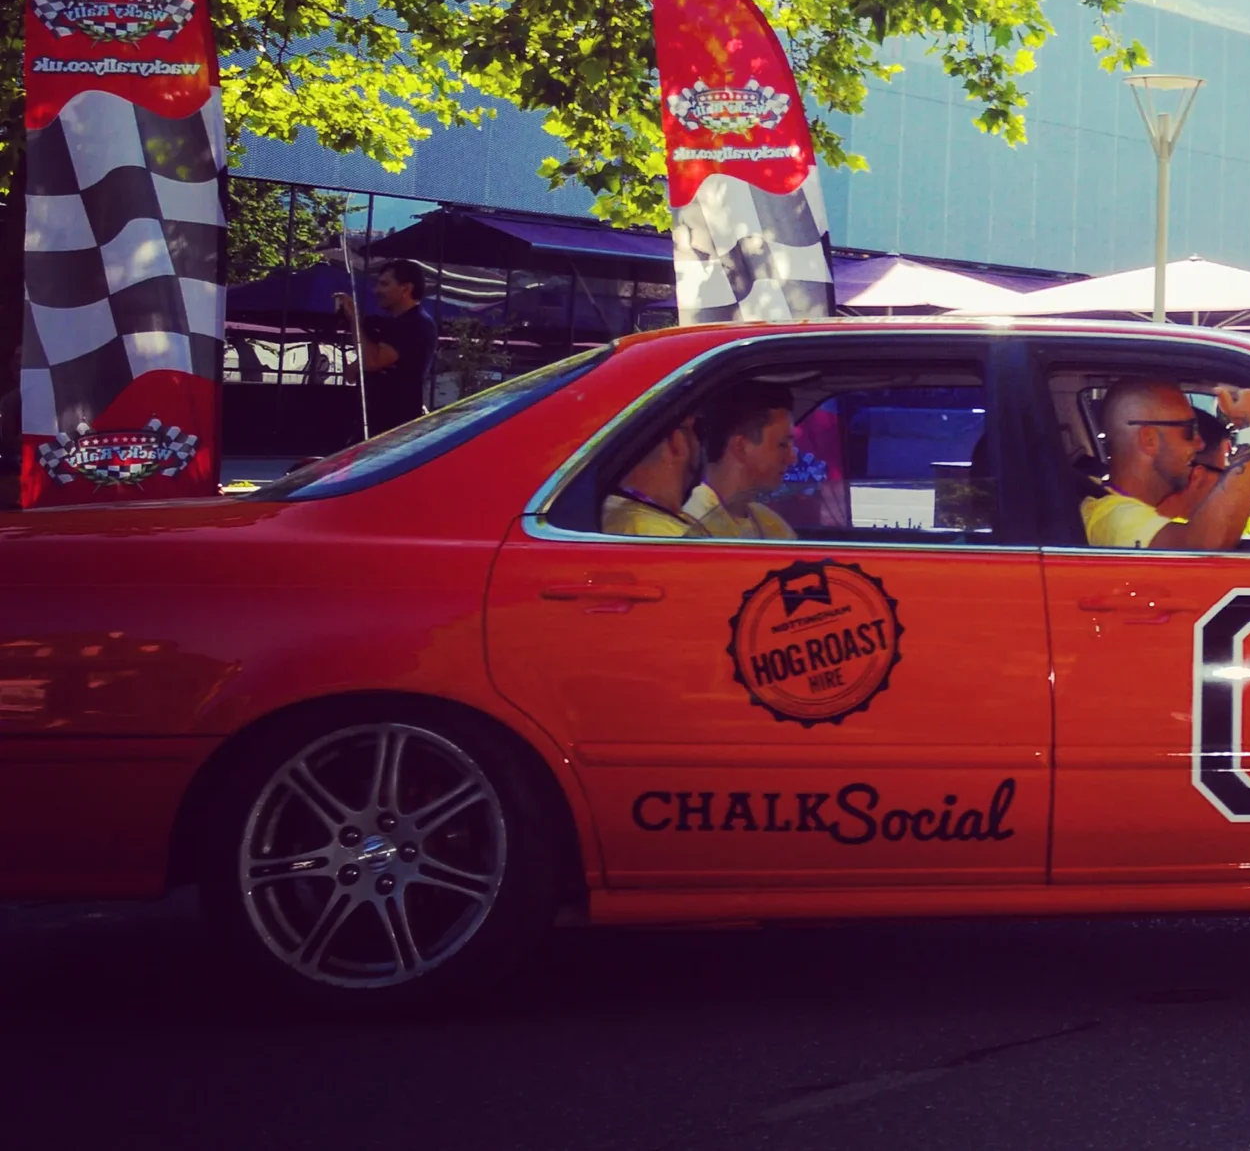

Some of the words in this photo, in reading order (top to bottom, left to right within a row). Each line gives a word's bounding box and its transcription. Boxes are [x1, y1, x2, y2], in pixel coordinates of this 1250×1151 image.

[750, 643, 807, 687] HOG
[805, 618, 888, 671] ROAST
[808, 667, 846, 694] HIRE
